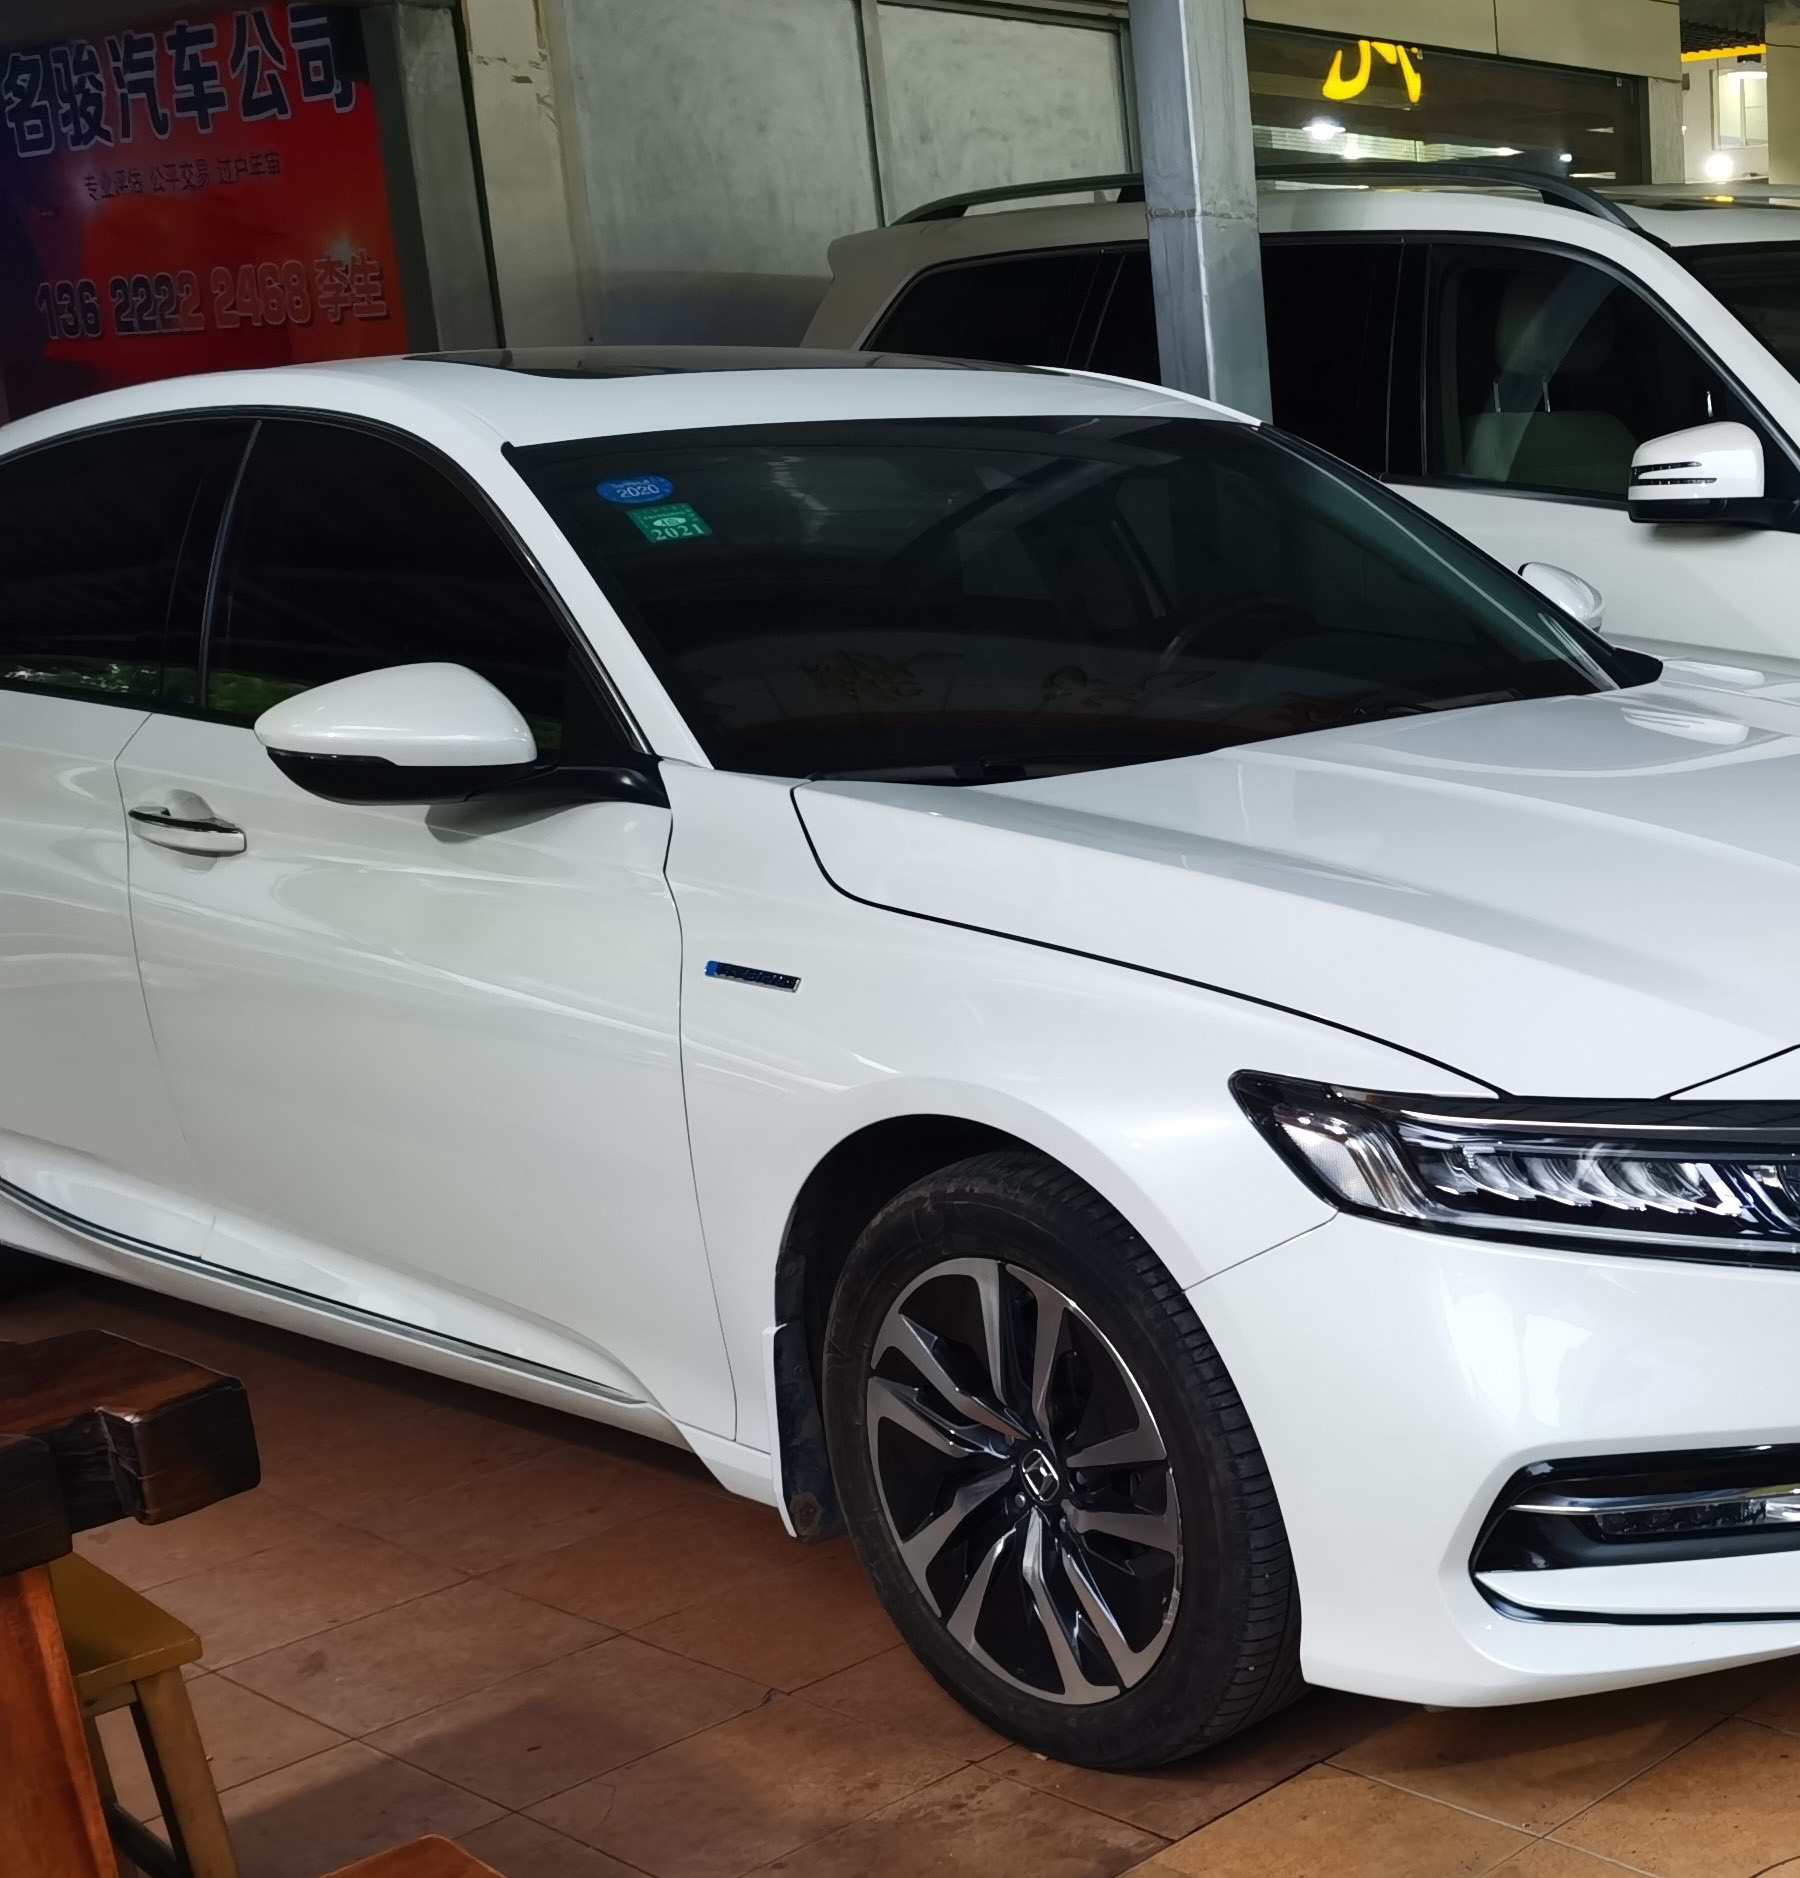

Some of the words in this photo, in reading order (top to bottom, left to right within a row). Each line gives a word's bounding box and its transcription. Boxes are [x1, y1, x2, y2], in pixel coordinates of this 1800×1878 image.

[2, 4, 355, 158] 名骏汽车公司
[35, 278, 101, 339] 136
[110, 269, 204, 336] 2222
[211, 260, 311, 328] 2468
[313, 247, 388, 322] 李生
[616, 484, 660, 499] 2020
[651, 523, 705, 541] 2021
